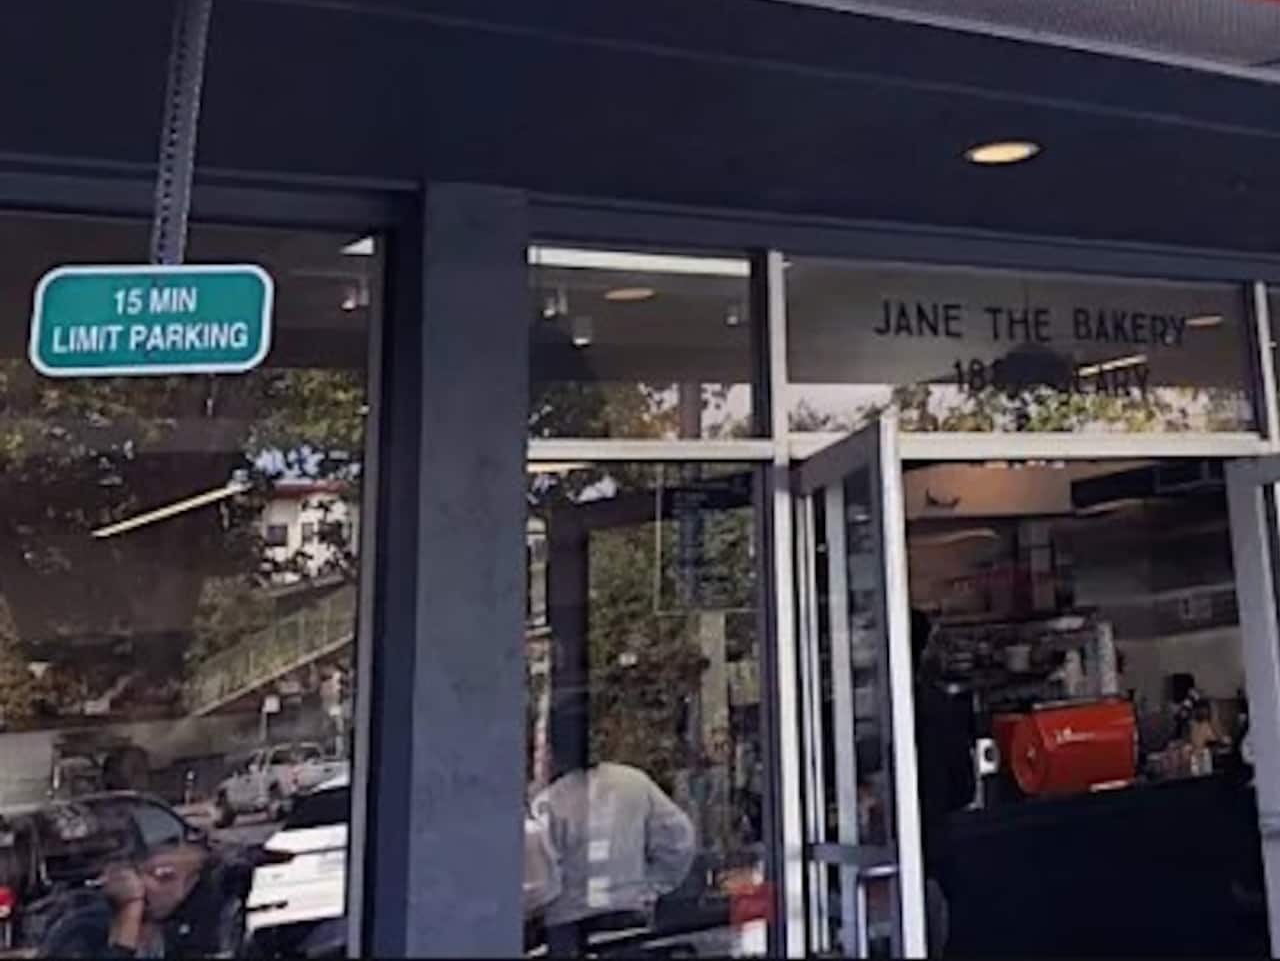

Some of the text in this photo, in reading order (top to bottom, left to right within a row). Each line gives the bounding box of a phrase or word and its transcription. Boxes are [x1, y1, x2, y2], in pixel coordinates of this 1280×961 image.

[114, 287, 197, 315] 15 MIN
[53, 322, 249, 354] LIMIT PARKING
[873, 301, 1187, 344] JANE THE BAKERY
